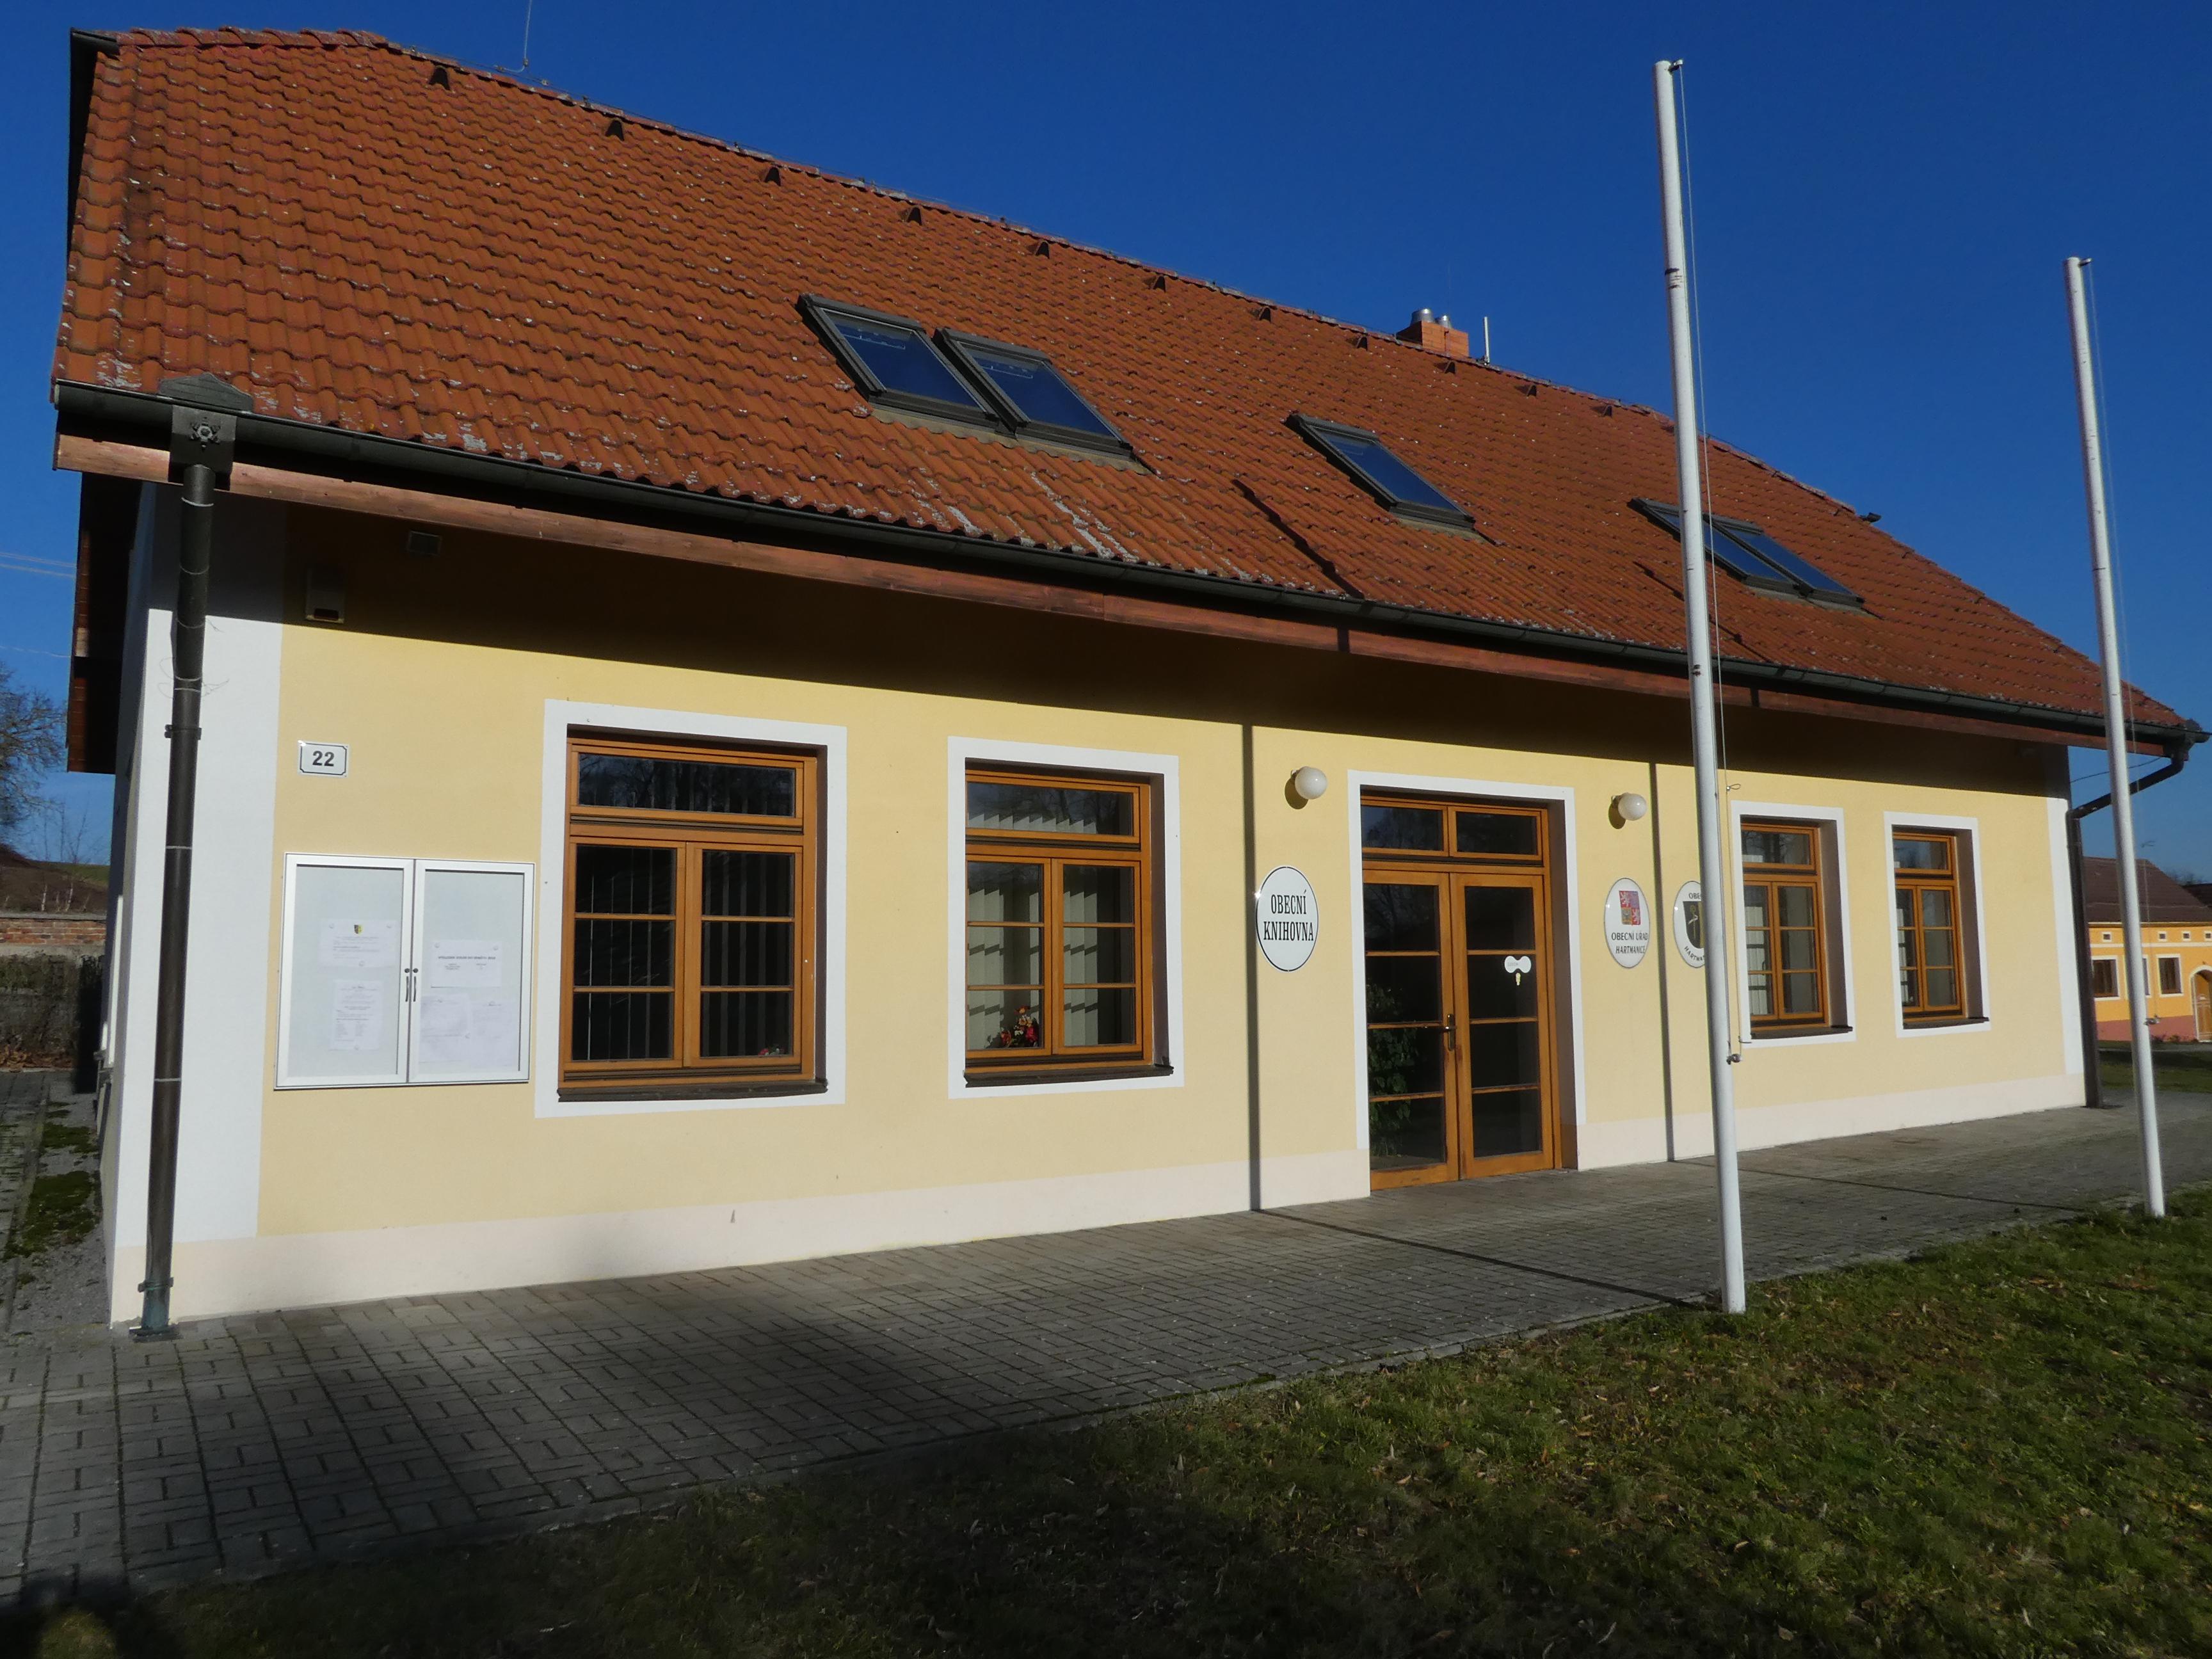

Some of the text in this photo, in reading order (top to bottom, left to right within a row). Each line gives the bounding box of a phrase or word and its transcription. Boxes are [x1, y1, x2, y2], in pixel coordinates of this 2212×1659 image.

[312, 751, 334, 767] 22
[1270, 890, 1306, 915] OBECNÍ
[1263, 921, 1314, 942] KNIHOVNA
[1683, 945, 1704, 961] HARTMA
